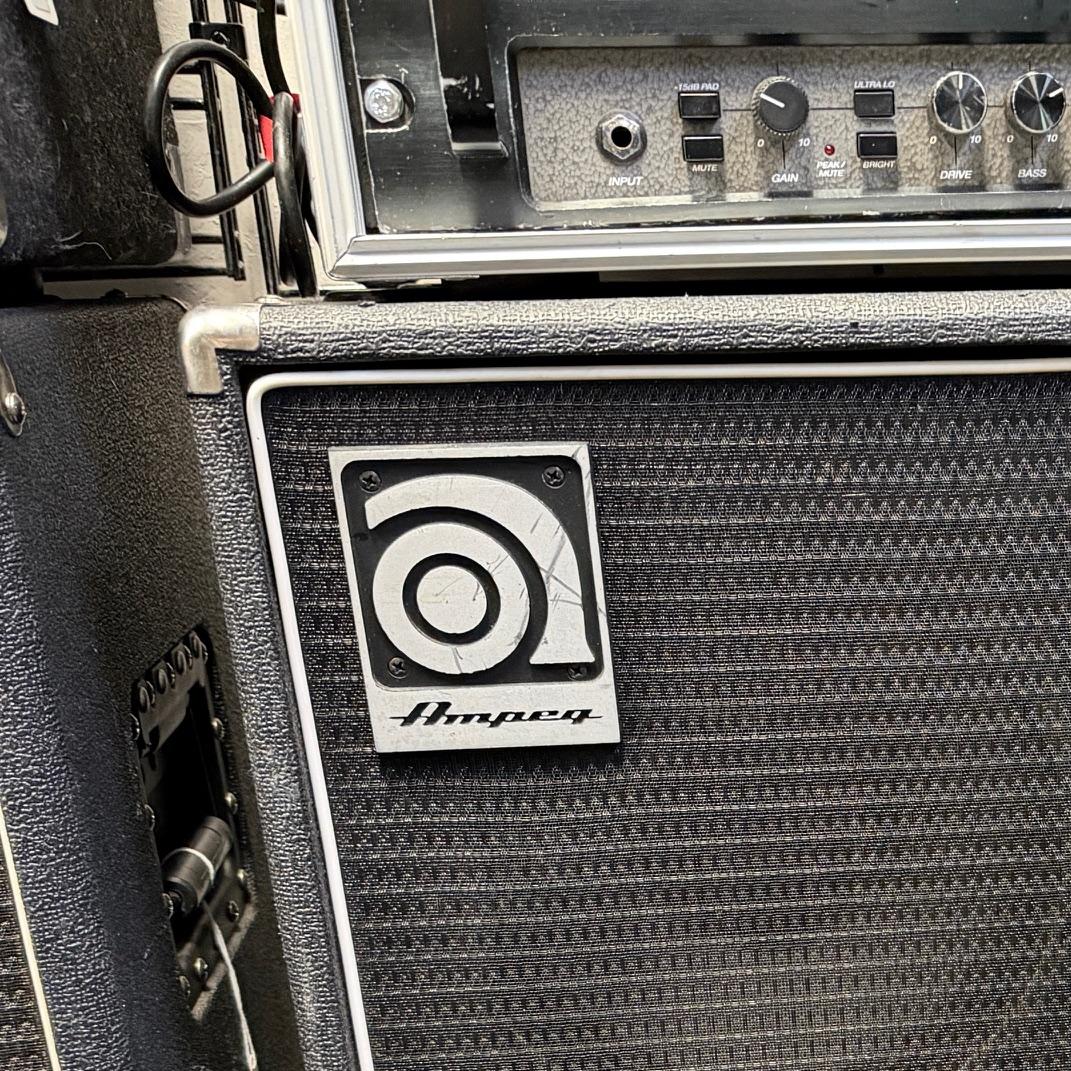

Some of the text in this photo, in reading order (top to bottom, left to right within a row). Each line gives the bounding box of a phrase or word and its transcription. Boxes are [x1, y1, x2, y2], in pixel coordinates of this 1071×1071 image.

[701, 82, 720, 90] PAD
[757, 138, 765, 148] 0
[799, 138, 811, 147] 10
[929, 136, 937, 144] 0
[970, 135, 982, 144] 10
[1007, 135, 1014, 143] 0
[1047, 134, 1058, 143] 10
[692, 164, 719, 172] MUTE
[817, 161, 846, 169] PEAK/
[863, 161, 896, 169] BRIGHT
[818, 169, 845, 177] MUTE
[940, 170, 973, 180] DRIVE
[1018, 168, 1047, 178] BASS
[609, 176, 643, 186] INPUT
[771, 173, 799, 183] GAIN
[389, 702, 603, 728] Ampeg
